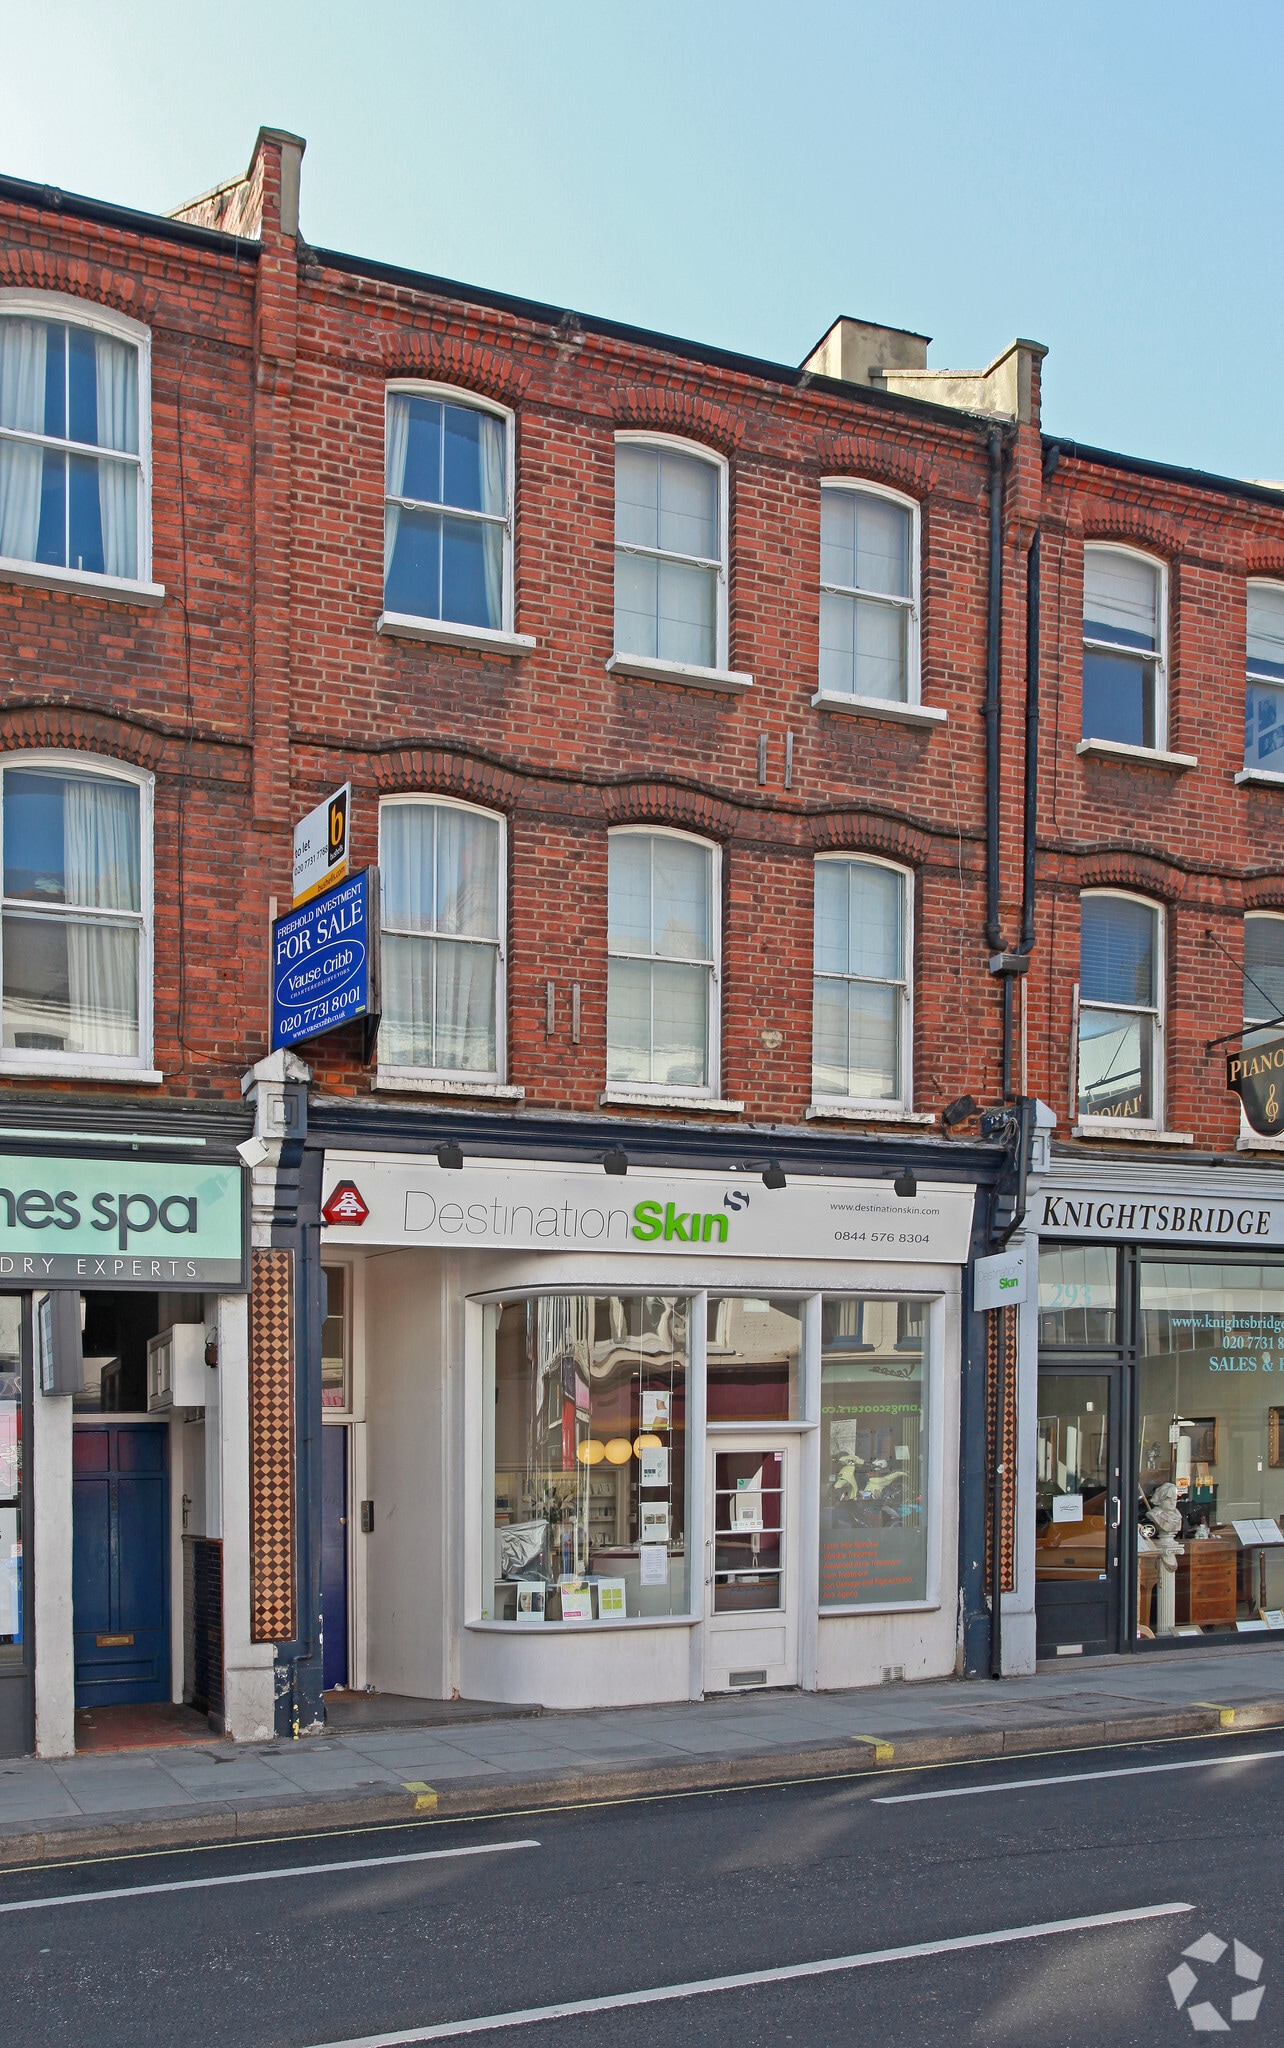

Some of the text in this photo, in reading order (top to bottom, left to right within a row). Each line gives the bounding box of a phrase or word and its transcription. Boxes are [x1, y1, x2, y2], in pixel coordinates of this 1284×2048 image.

[331, 803, 343, 846] b
[294, 839, 311, 859] to let
[294, 862, 303, 876] 020
[304, 854, 316, 870] 7731
[277, 882, 363, 939] FREEHOLD INVESTMENT
[276, 899, 363, 966] FOR SALE
[288, 948, 353, 991] Vause Cribb
[280, 985, 360, 1035] 020 7731 8001
[404, 1190, 729, 1243] Destination Skin
[830, 1203, 940, 1216] www.destinationskin.com
[1041, 1196, 1271, 1236] KNIGHTSBRIDGE
[91, 1192, 197, 1250] spa
[834, 1231, 930, 1244] 0844 576 8304
[0, 1257, 197, 1277] DRY EXPERTS
[999, 1277, 1019, 1290] Skin
[1050, 1282, 1092, 1308] 293
[1222, 1335, 1245, 1350] 020
[1246, 1336, 1274, 1350] 7731
[1209, 1356, 1257, 1372] SALES
[1261, 1357, 1274, 1372] &
[847, 1551, 877, 1559] Treatment
[837, 1570, 868, 1579] Treatment
